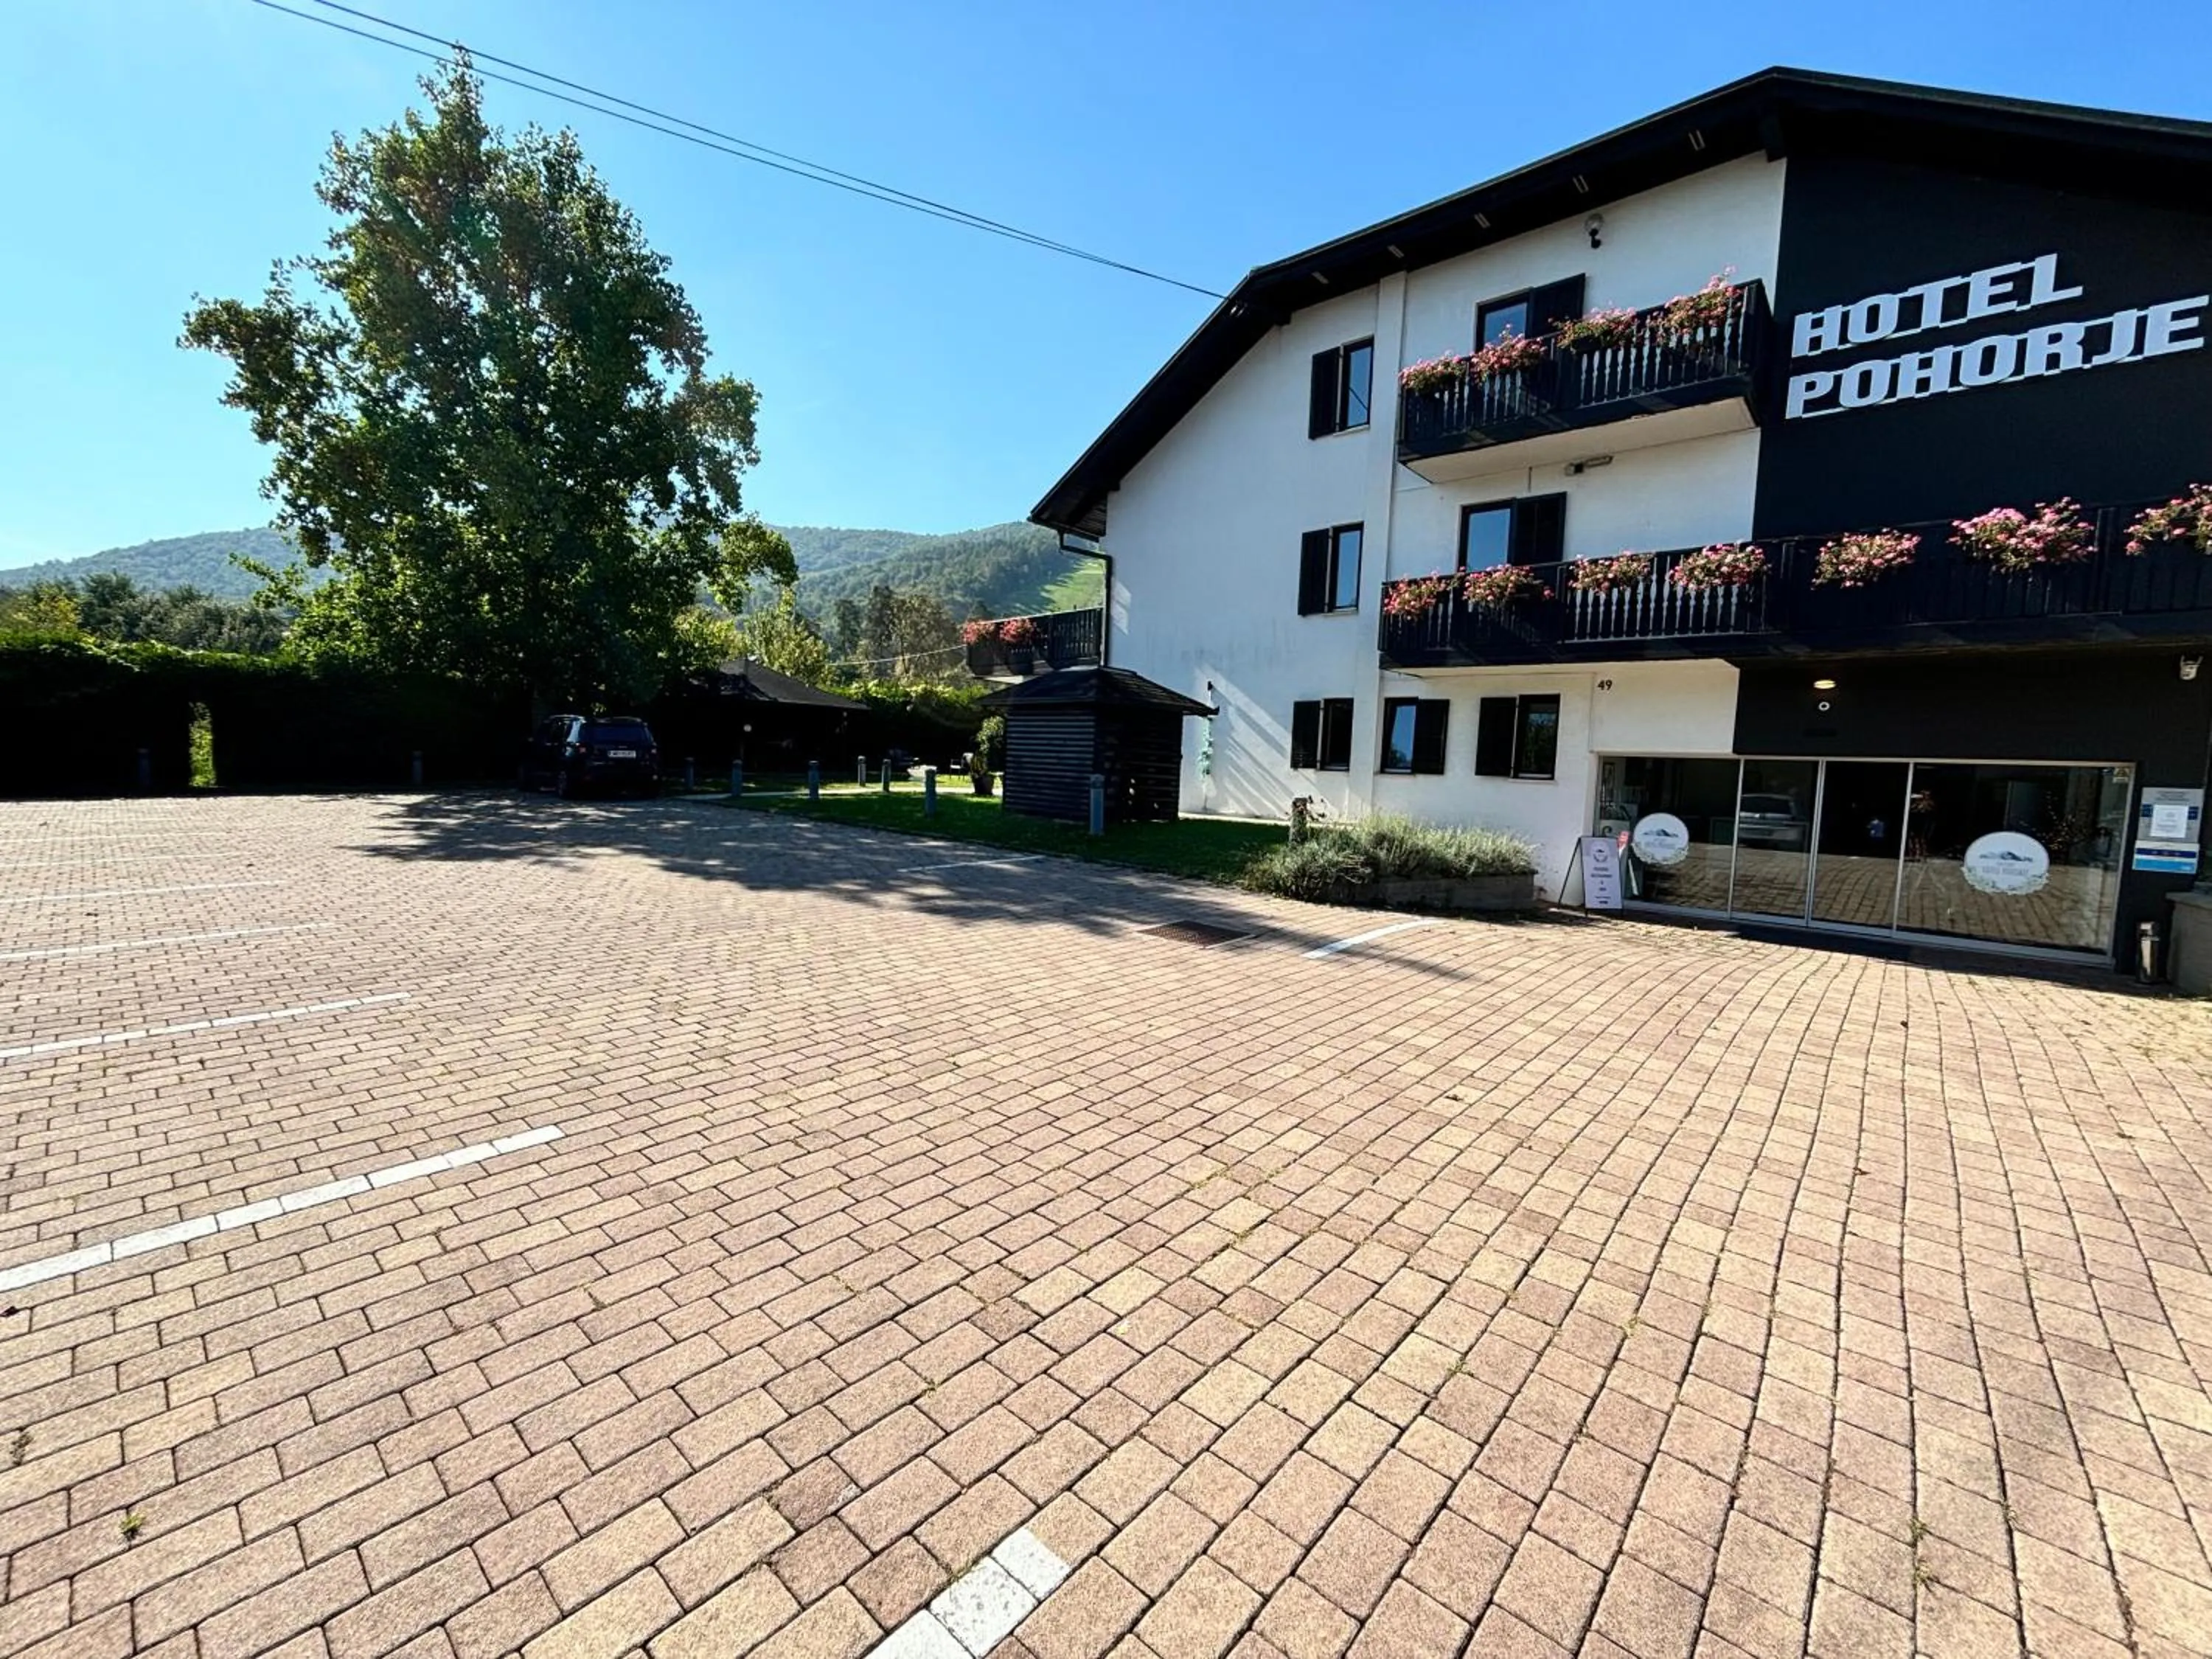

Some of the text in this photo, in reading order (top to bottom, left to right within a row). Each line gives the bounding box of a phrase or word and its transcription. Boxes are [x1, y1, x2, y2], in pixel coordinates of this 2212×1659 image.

[1785, 295, 2210, 420] POHORJE
[1792, 253, 2083, 358] HOTEL
[1597, 679, 1613, 691] 49
